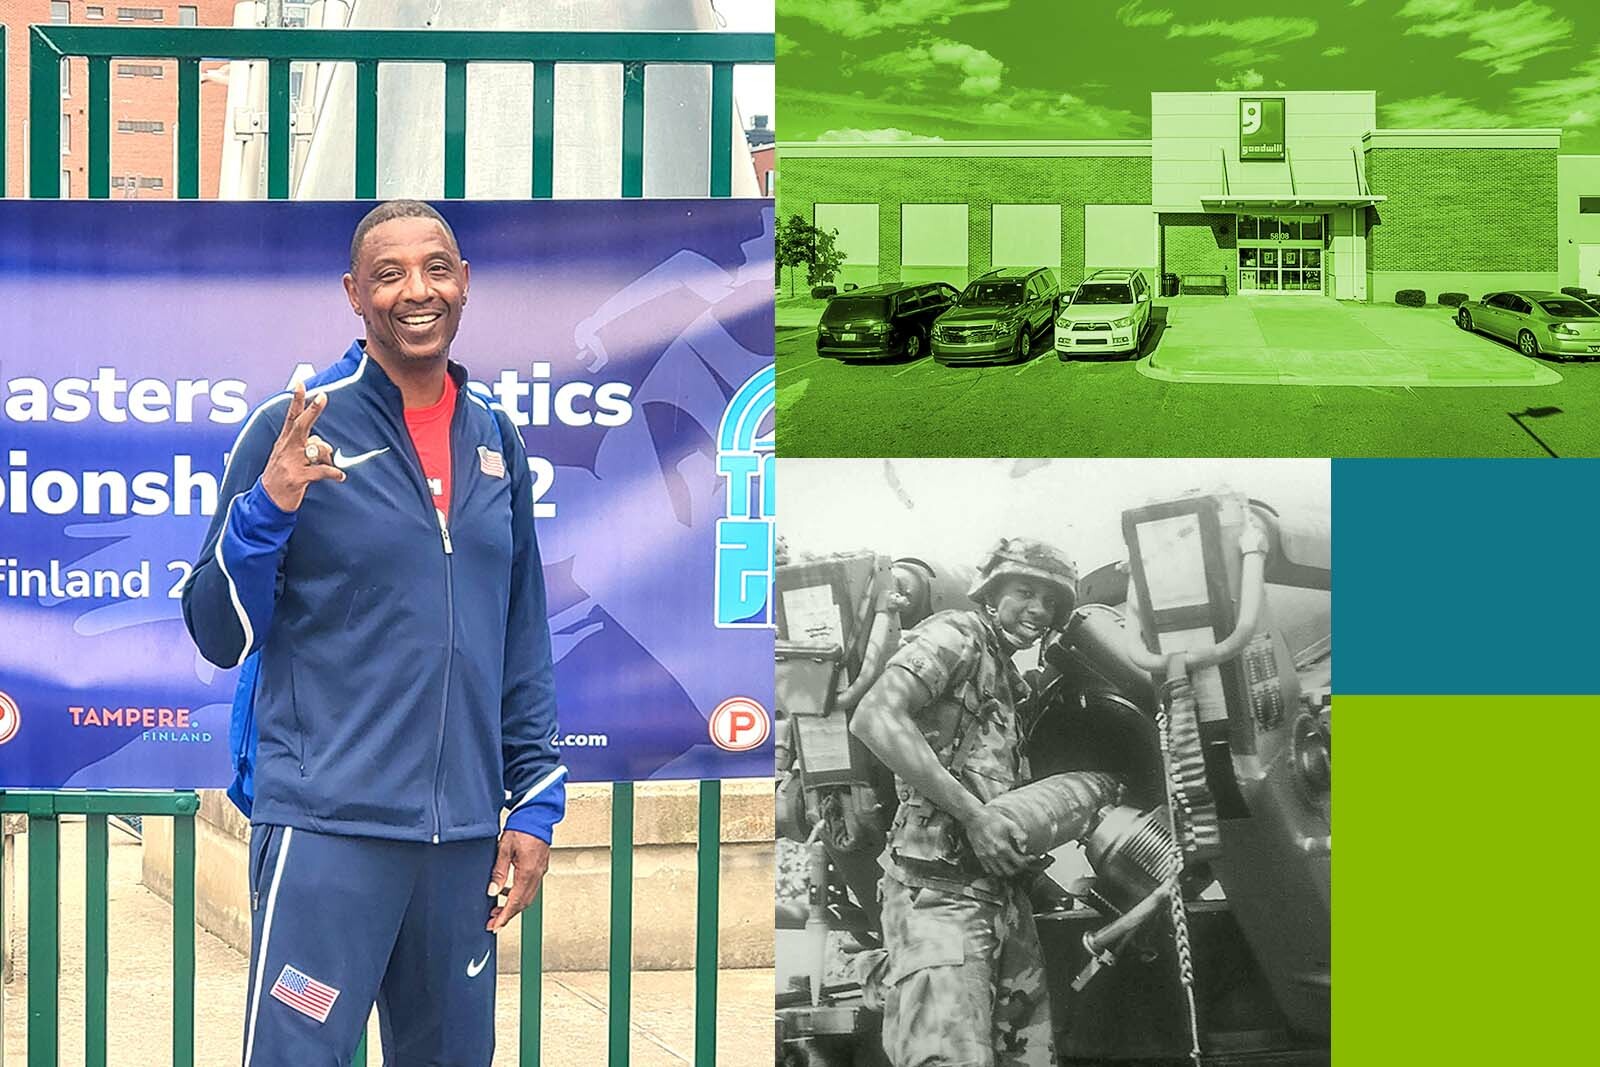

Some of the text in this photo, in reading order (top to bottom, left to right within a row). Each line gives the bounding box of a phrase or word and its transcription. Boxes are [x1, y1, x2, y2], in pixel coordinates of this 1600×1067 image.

[1242, 143, 1283, 156] goodwill
[1270, 232, 1290, 240] 5808
[68, 706, 199, 729] TAMPERE.
[729, 711, 756, 743] P
[142, 731, 213, 743] FINLAND
